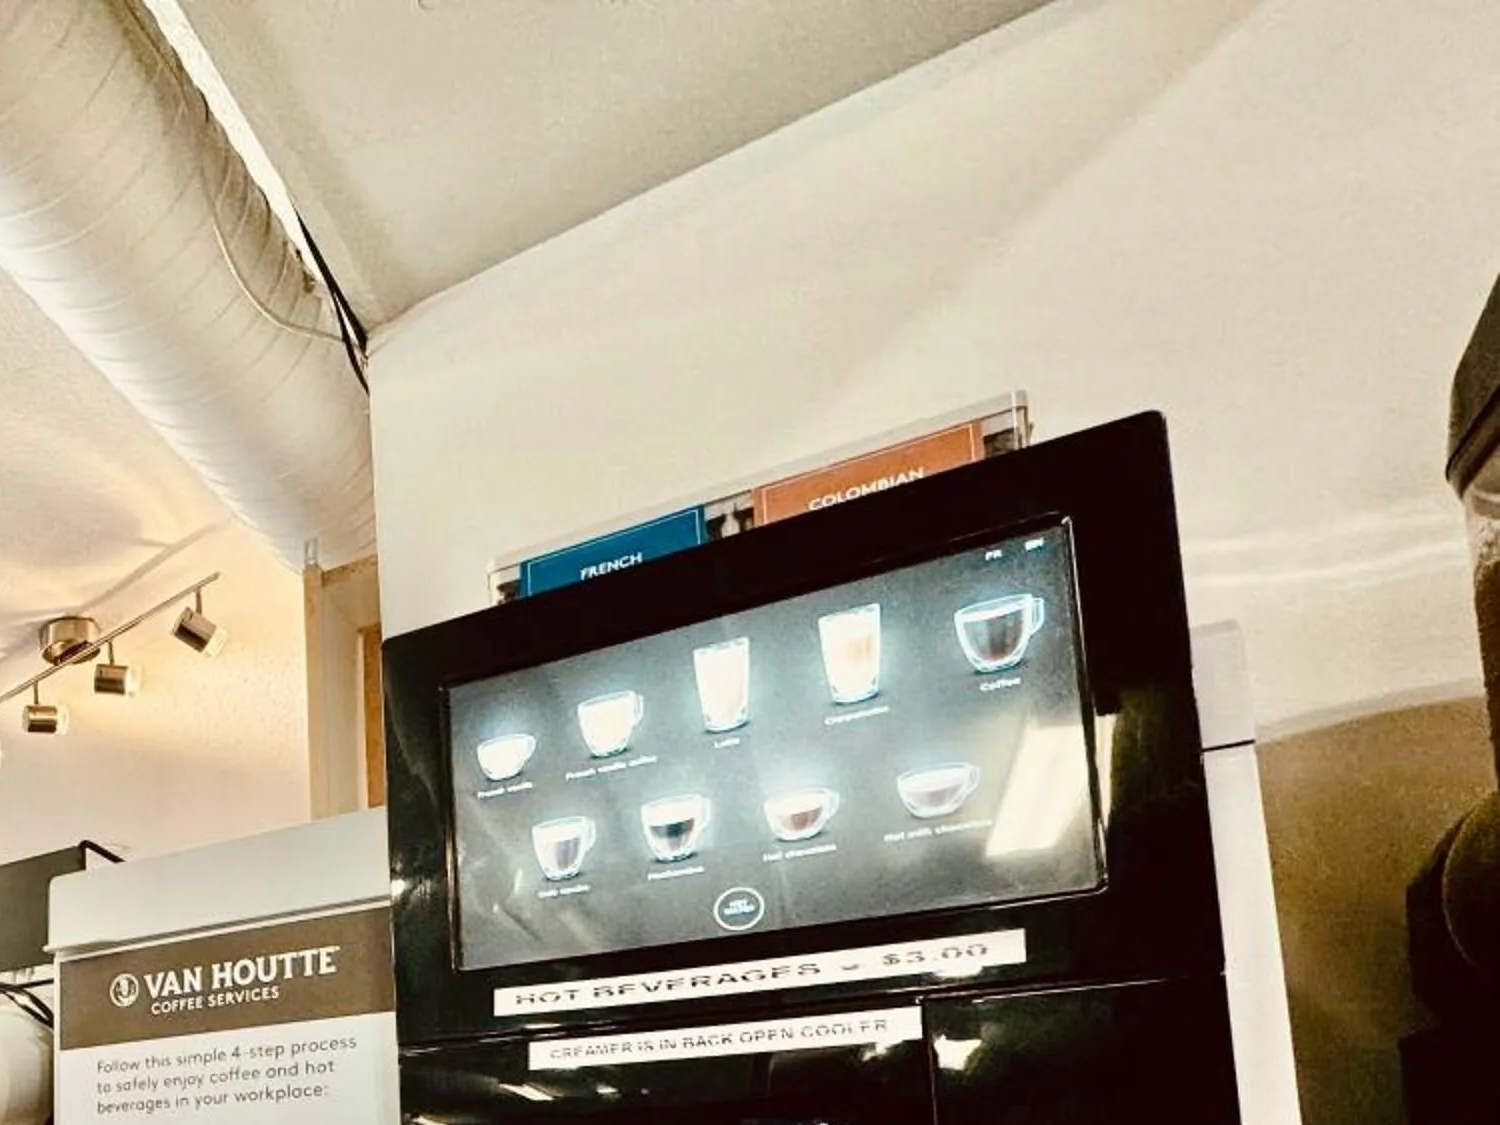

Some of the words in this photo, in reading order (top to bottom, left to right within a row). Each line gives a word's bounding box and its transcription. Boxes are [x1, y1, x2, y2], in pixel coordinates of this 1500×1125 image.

[808, 466, 926, 512] COLOMBIAN
[579, 552, 643, 581] FRENCH
[144, 966, 202, 998] VAN
[211, 947, 337, 989] HOUTTE
[515, 989, 581, 1005] HOT
[594, 963, 822, 998] BEVERAGES
[883, 943, 988, 965] $3.00
[151, 998, 203, 1015] COFFEE
[207, 986, 280, 1008] SERVICES
[97, 1060, 140, 1073] Follow
[145, 1056, 171, 1069] this
[178, 1048, 227, 1066] simple
[291, 1038, 357, 1058] process
[549, 1044, 633, 1060] CREAMER
[659, 1038, 678, 1050] IN
[682, 1034, 735, 1049] BACK
[739, 1029, 795, 1044] OPEN
[97, 1083, 112, 1094] to
[116, 1077, 158, 1093] safely
[163, 1074, 204, 1091] enjoy
[209, 1066, 260, 1084] coffee
[265, 1062, 299, 1079] and
[305, 1060, 334, 1075] hot
[97, 1099, 170, 1115] beverages
[175, 1096, 189, 1109] in
[195, 1093, 228, 1111] your
[233, 1084, 329, 1104] workplace:
